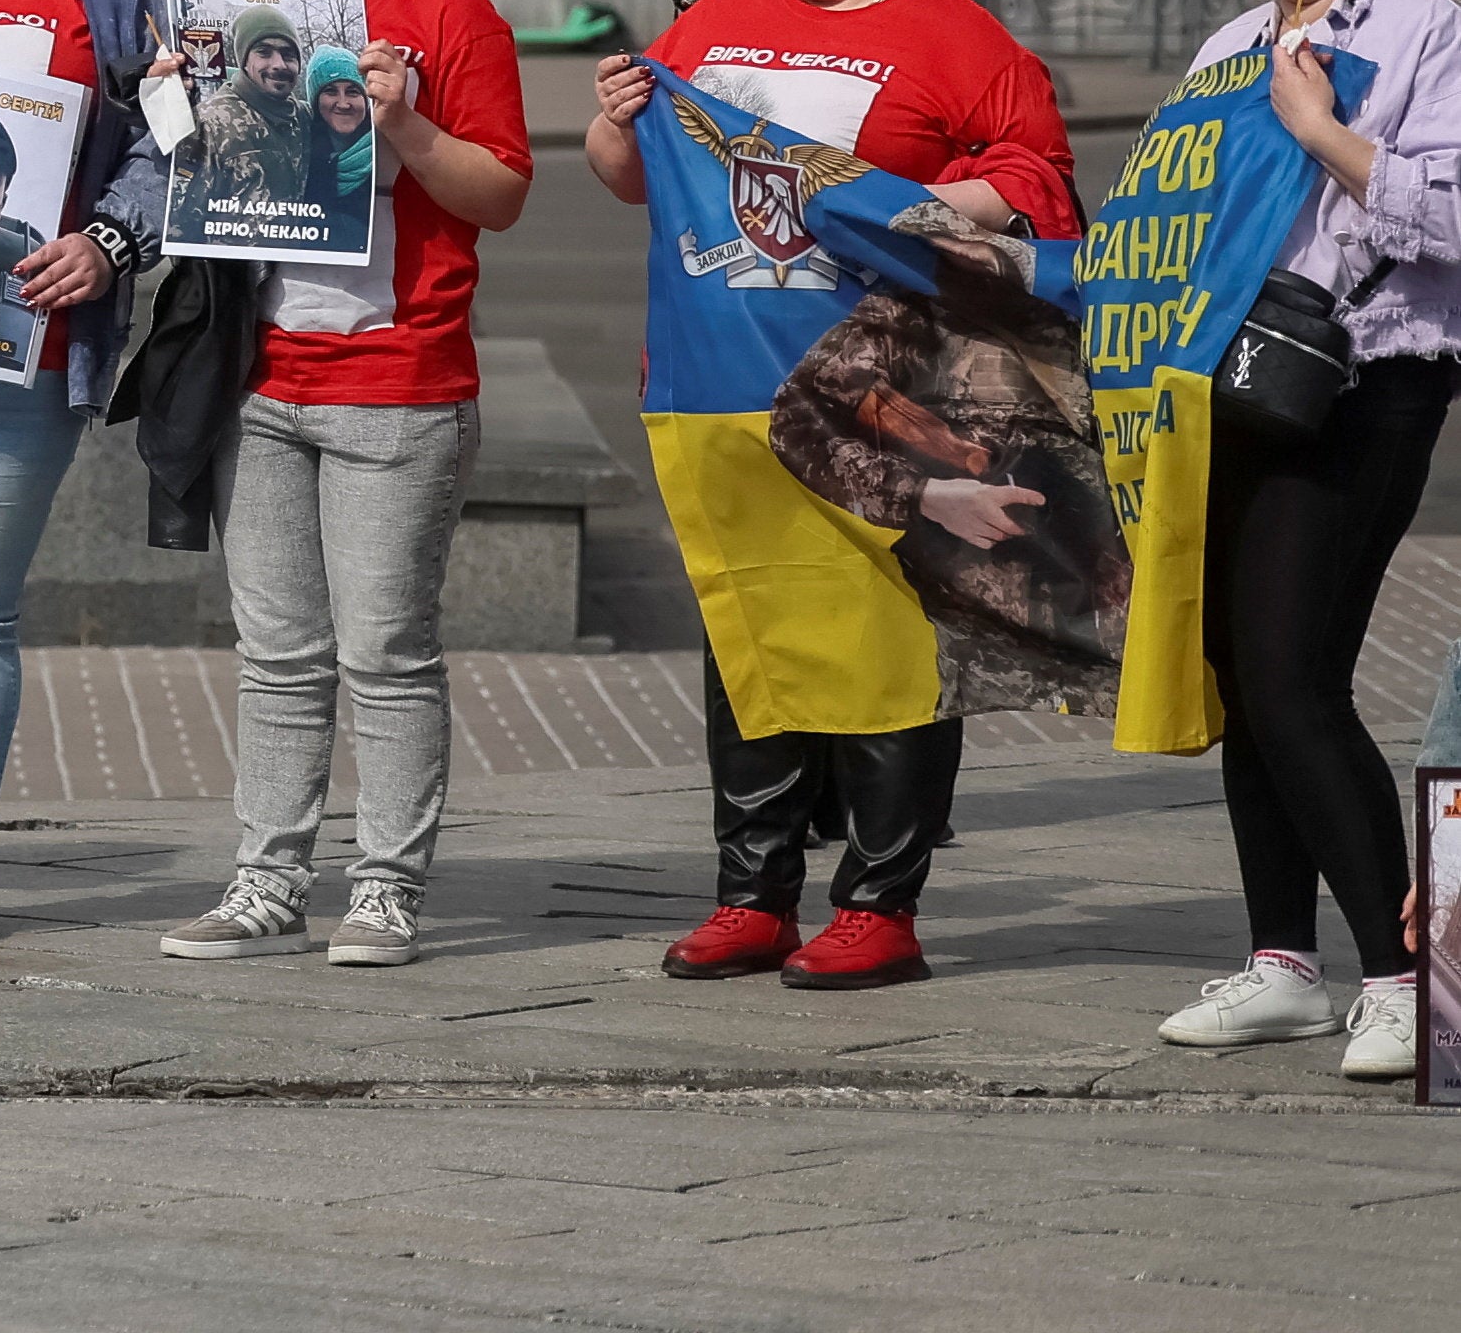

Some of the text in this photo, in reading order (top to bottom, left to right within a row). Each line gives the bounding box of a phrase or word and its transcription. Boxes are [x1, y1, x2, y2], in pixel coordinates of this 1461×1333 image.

[703, 46, 775, 65] ВІРЮ
[207, 196, 326, 220] МІЙ ДЯДЕЧКО,
[204, 221, 254, 238] ВІРЮ,
[258, 224, 320, 241] ЧЕКАЮ
[695, 241, 744, 271] ЗАВЖДИ
